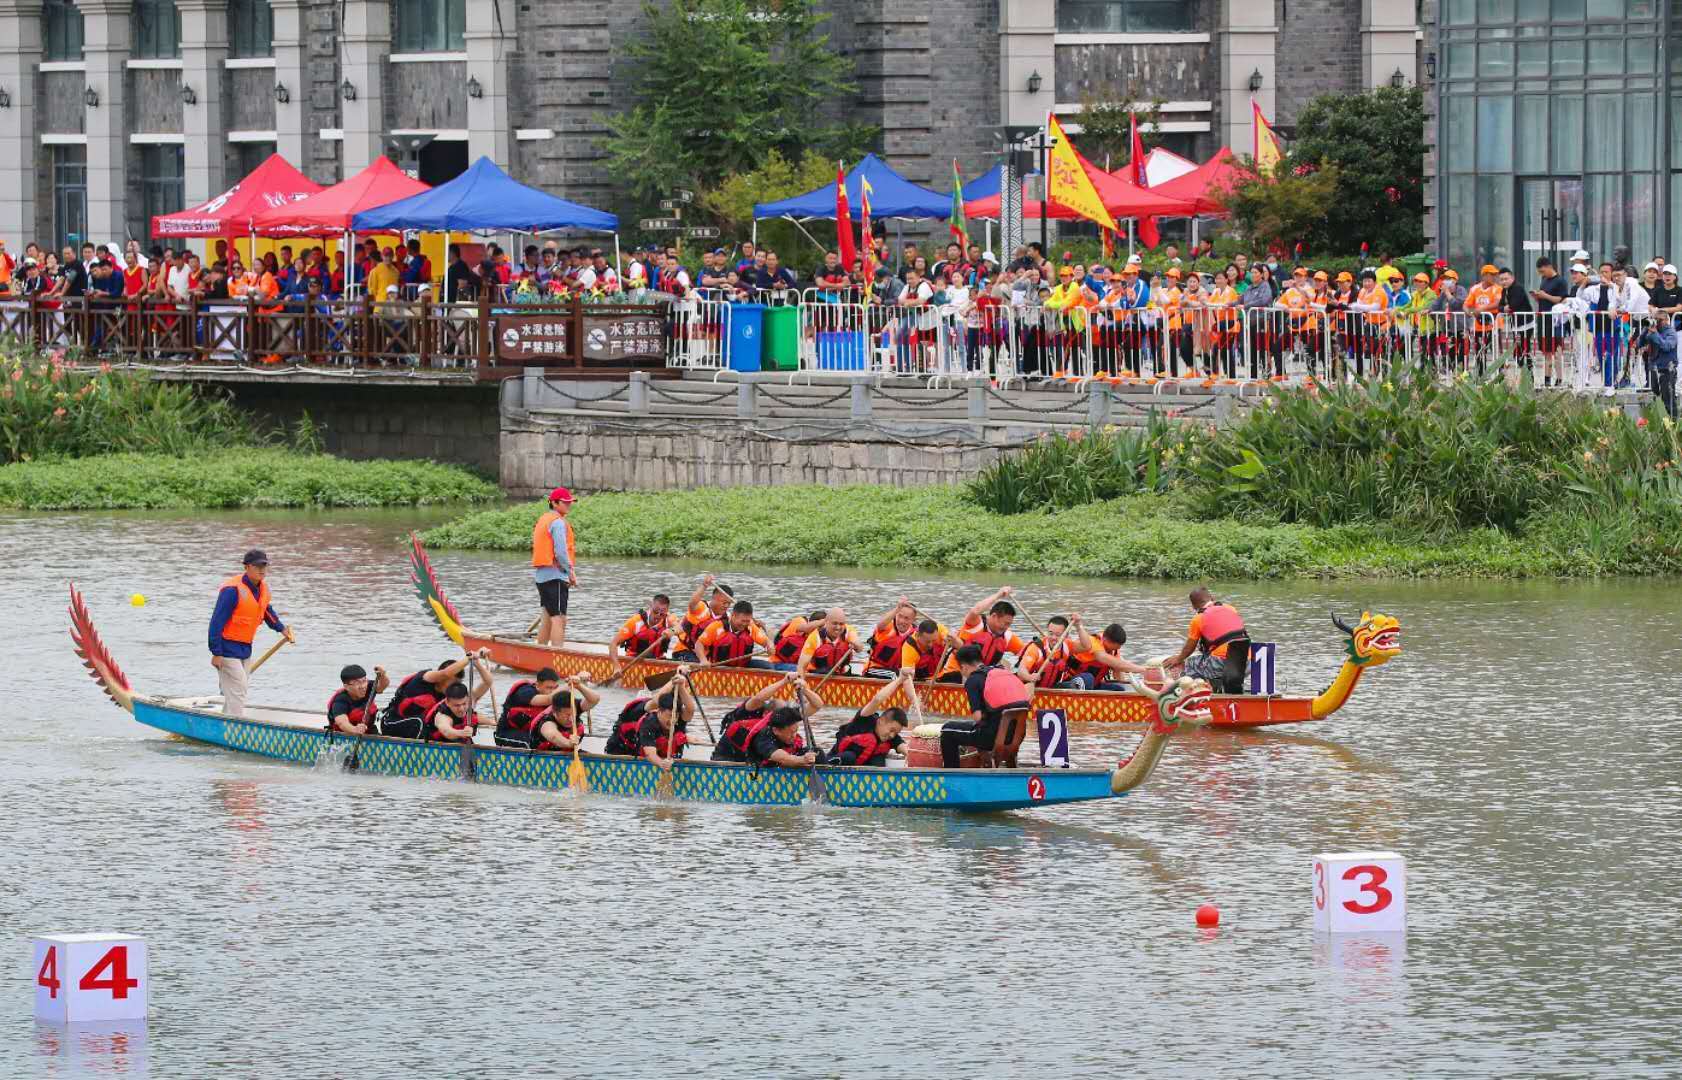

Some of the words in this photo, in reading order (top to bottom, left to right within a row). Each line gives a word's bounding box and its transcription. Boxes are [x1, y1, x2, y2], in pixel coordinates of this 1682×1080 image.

[521, 323, 566, 336] 水深危险
[609, 321, 662, 336] 水深危险
[521, 341, 566, 354] 严禁游泳
[609, 340, 661, 355] 严禁游泳
[1255, 646, 1270, 695] 1
[1228, 703, 1237, 721] 1
[1041, 711, 1066, 767] 2
[1031, 779, 1043, 800] 2
[1315, 862, 1325, 911] 3
[1342, 865, 1393, 915] 3
[38, 945, 61, 999] 4
[79, 945, 138, 999] 4
